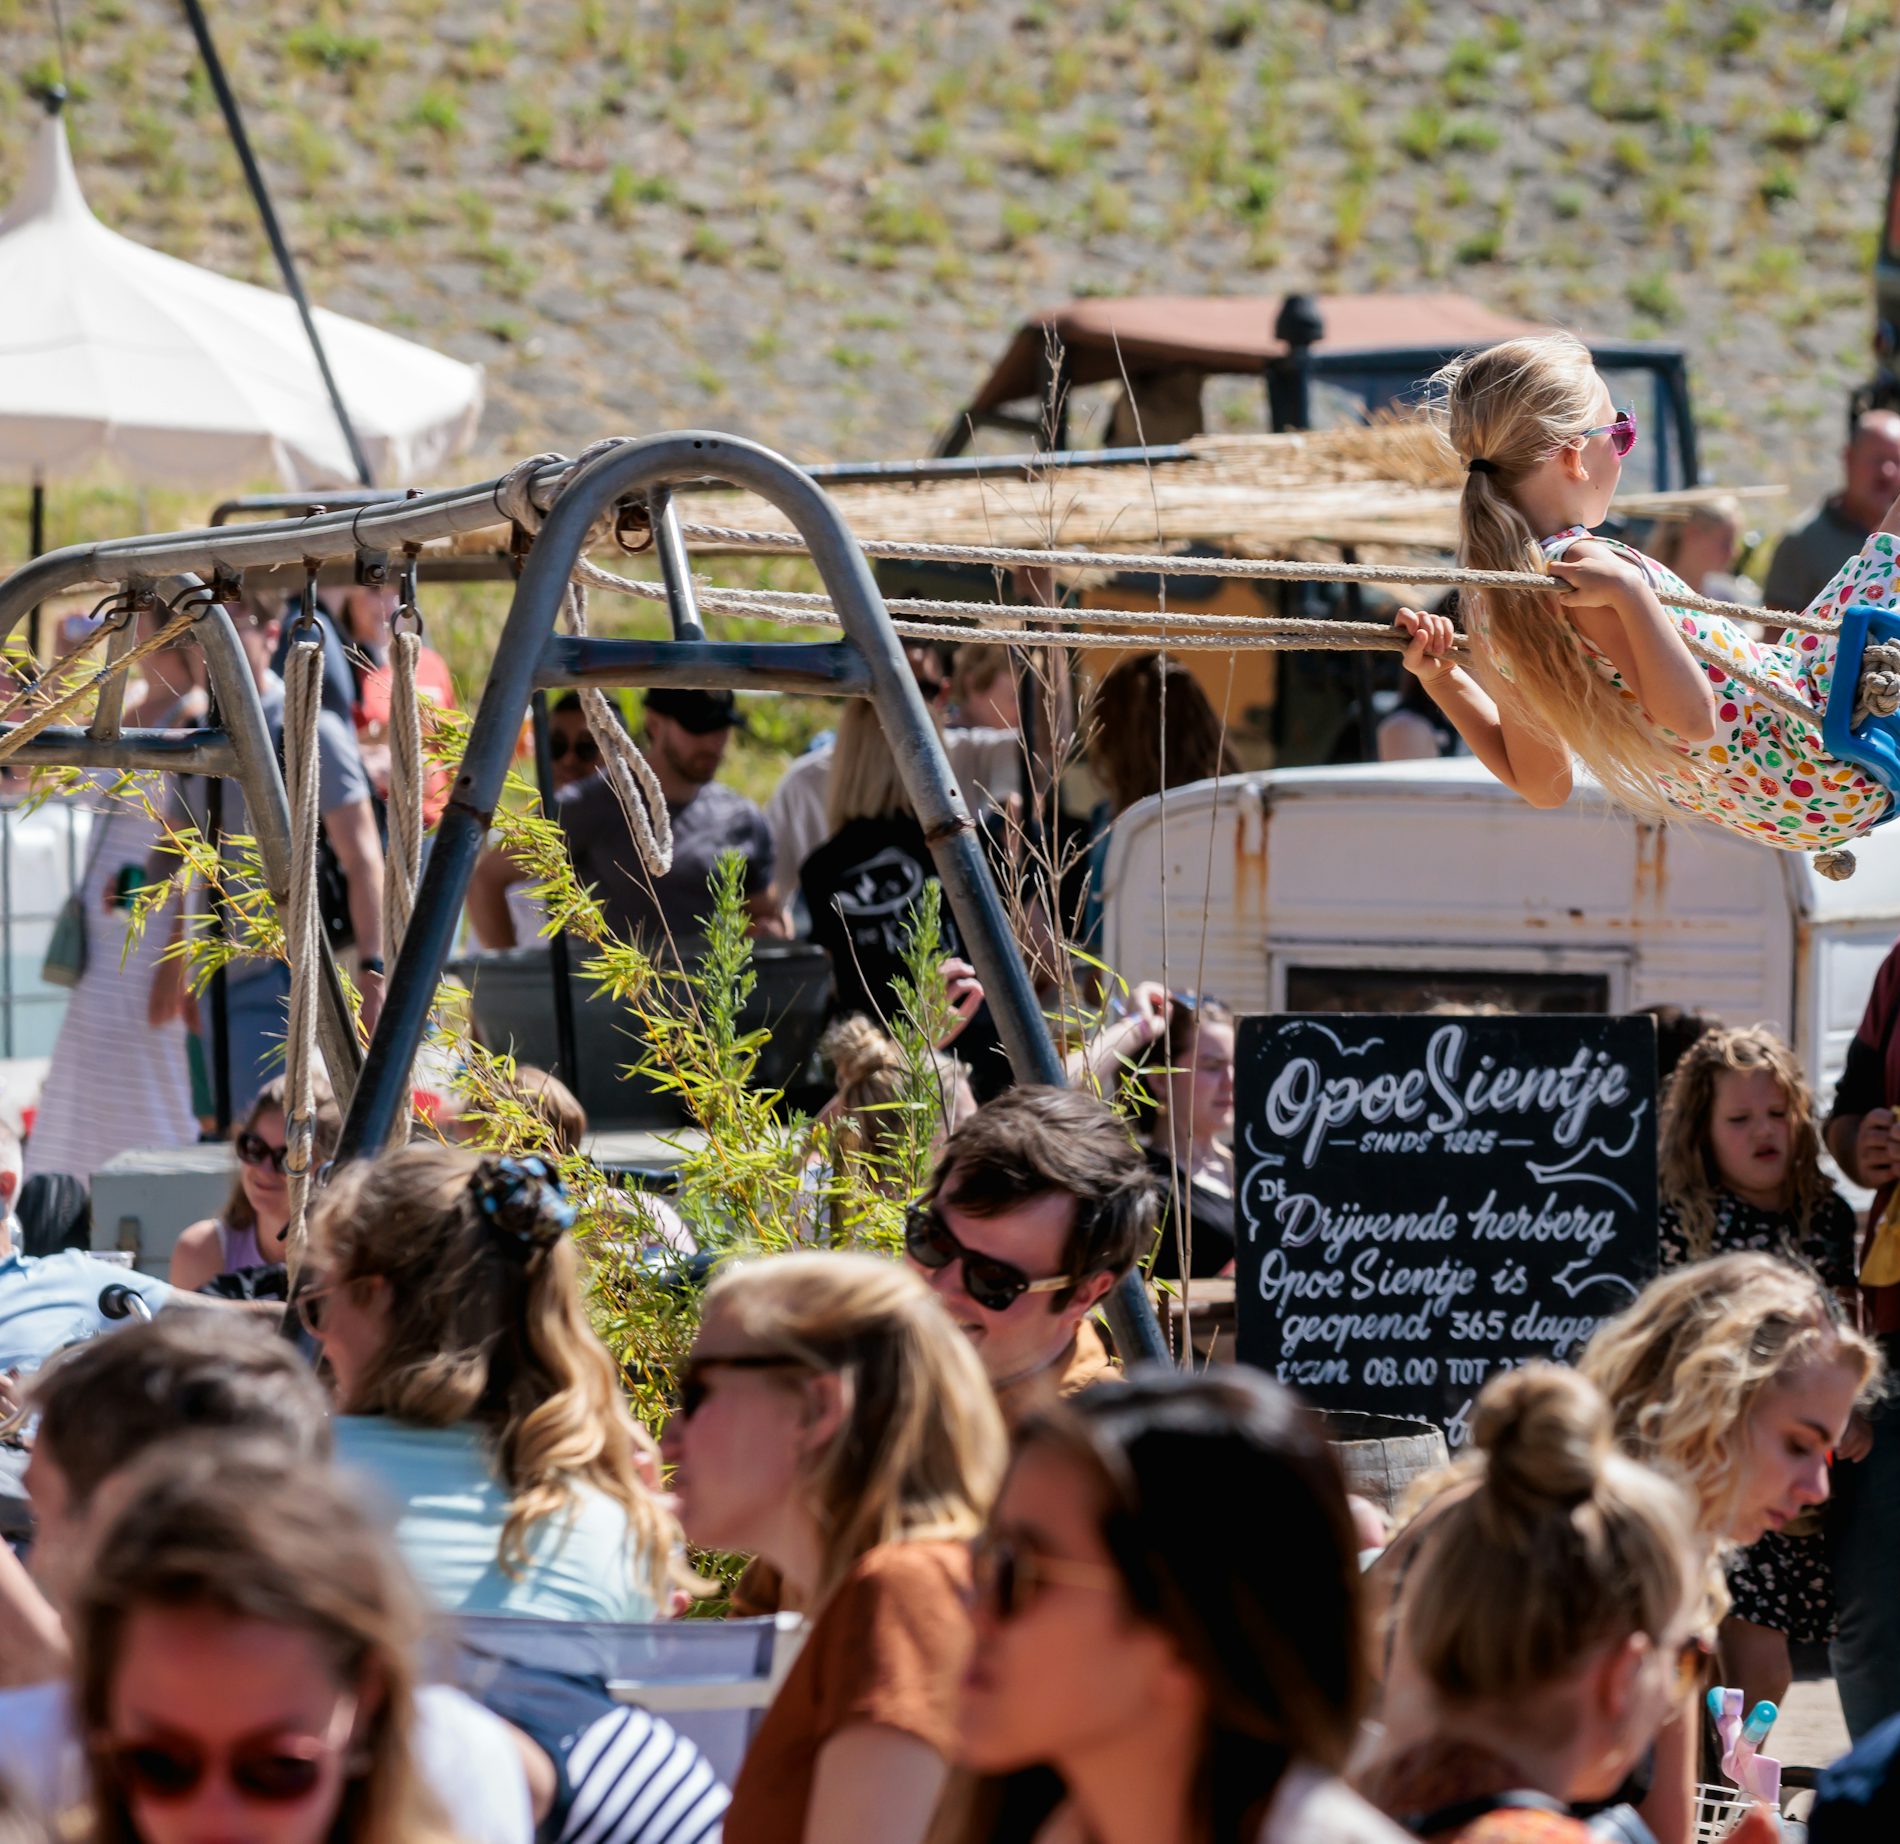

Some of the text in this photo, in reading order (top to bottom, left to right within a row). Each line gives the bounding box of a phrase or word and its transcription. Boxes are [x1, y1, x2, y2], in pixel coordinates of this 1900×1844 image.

[1360, 1130, 1498, 1153] SINDS 1885
[1259, 1179, 1286, 1201] DE
[1275, 1189, 1617, 1263] Drijvende herberg
[1491, 1259, 1528, 1294] is
[1281, 1300, 1432, 1358] geopend
[1450, 1310, 1506, 1341] 365
[1363, 1357, 1437, 1387] 08.00
[1446, 1358, 1490, 1385] TOT
